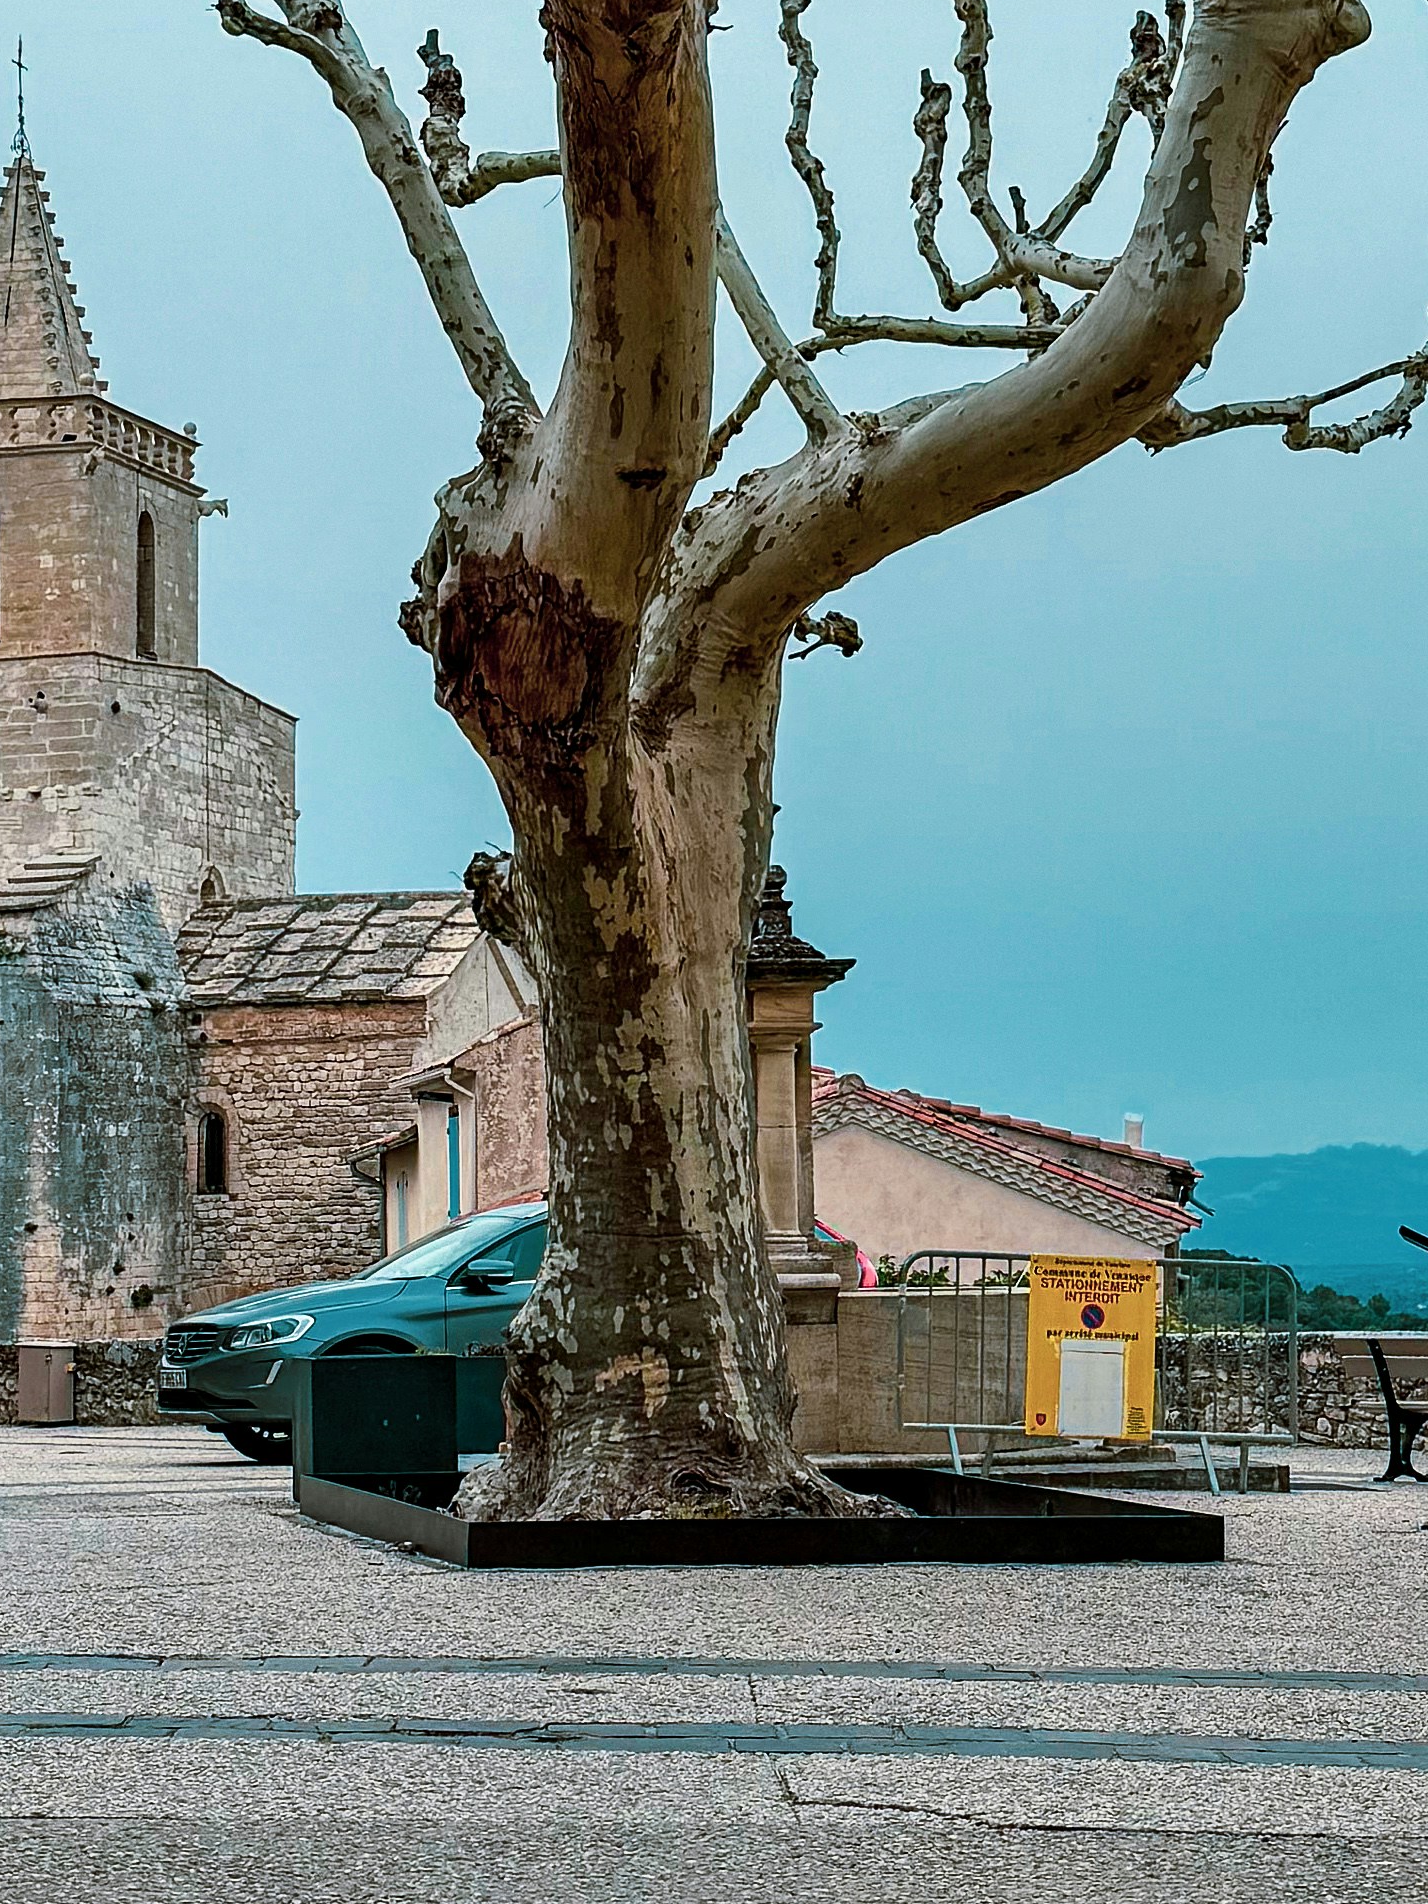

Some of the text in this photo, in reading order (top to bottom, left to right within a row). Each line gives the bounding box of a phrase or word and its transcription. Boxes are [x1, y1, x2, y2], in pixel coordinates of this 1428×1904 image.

[1034, 1266, 1088, 1278] Commune
[1090, 1269, 1101, 1279] de
[1040, 1278, 1144, 1293] STATIONNEMENT
[1065, 1291, 1121, 1304] INTERDIT
[1095, 1331, 1139, 1342] municipal
